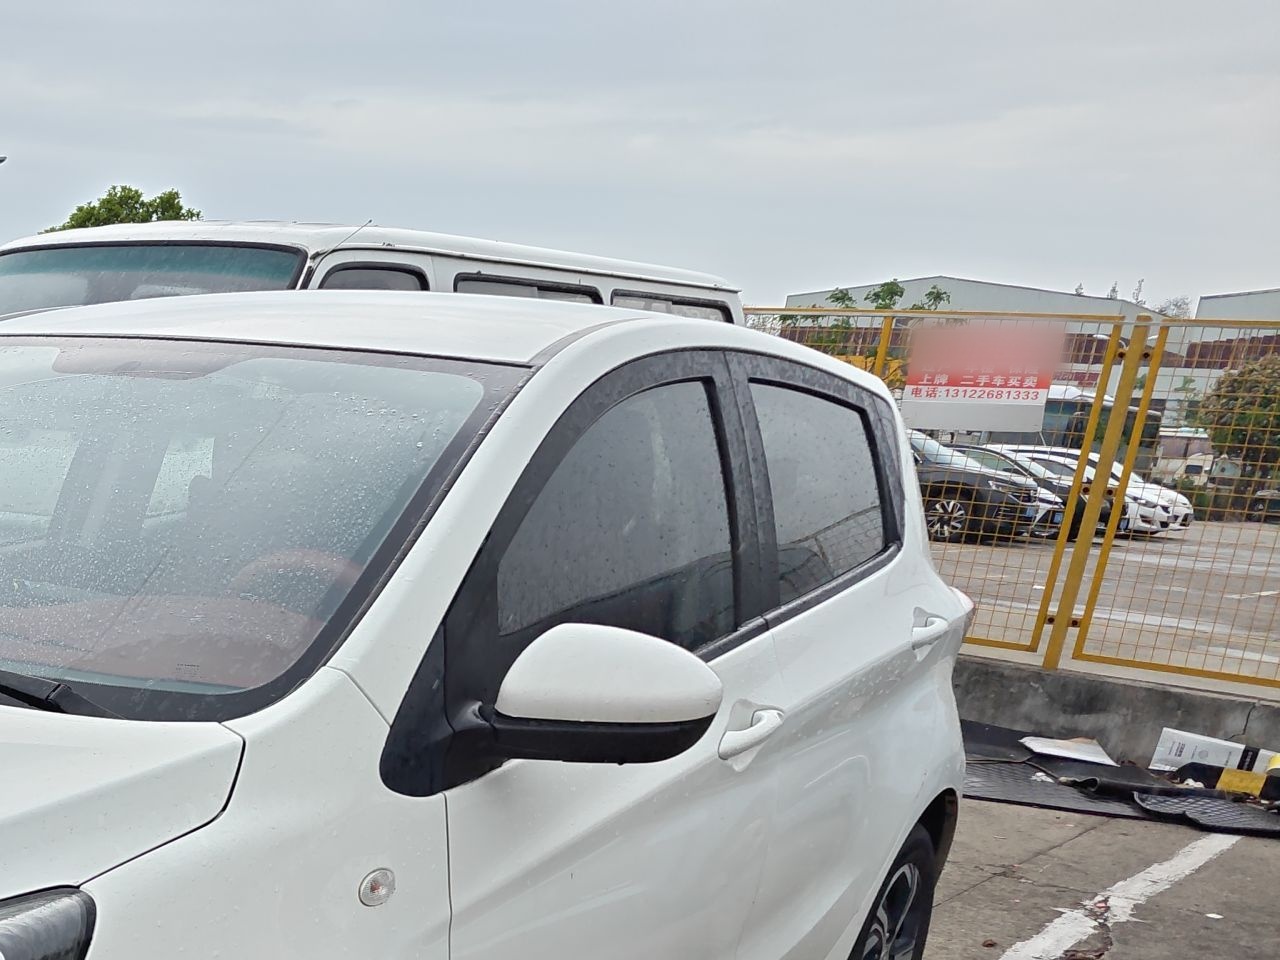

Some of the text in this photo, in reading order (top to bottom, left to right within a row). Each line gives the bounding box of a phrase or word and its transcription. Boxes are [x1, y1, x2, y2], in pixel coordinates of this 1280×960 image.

[919, 374, 949, 385] 上牌
[960, 375, 1038, 387] 二手车买卖
